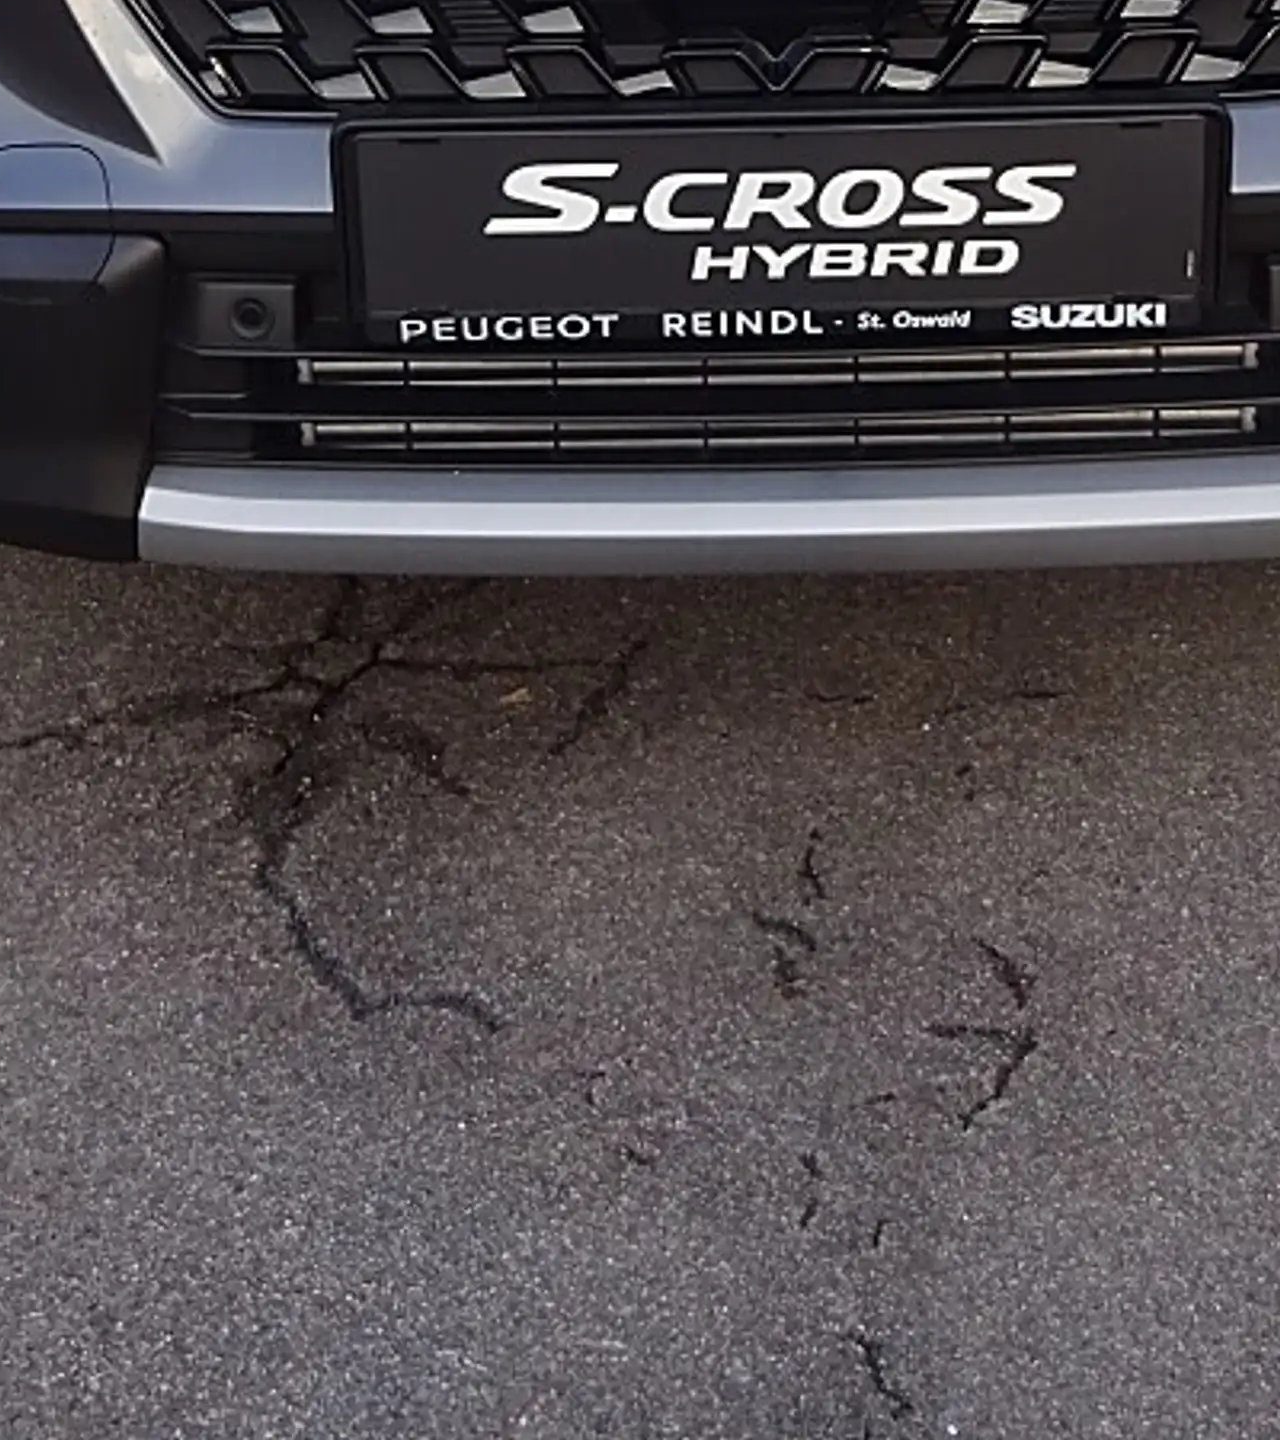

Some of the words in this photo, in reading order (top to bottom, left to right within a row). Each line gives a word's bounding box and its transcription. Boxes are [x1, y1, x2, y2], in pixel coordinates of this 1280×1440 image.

[484, 162, 1077, 235] S-CROSS
[691, 239, 1020, 281] HYBRID
[399, 313, 620, 344] PEUGEOT
[662, 309, 824, 338] REINDL
[892, 310, 972, 329] Oswald
[1010, 303, 1167, 330] SUZUKI
